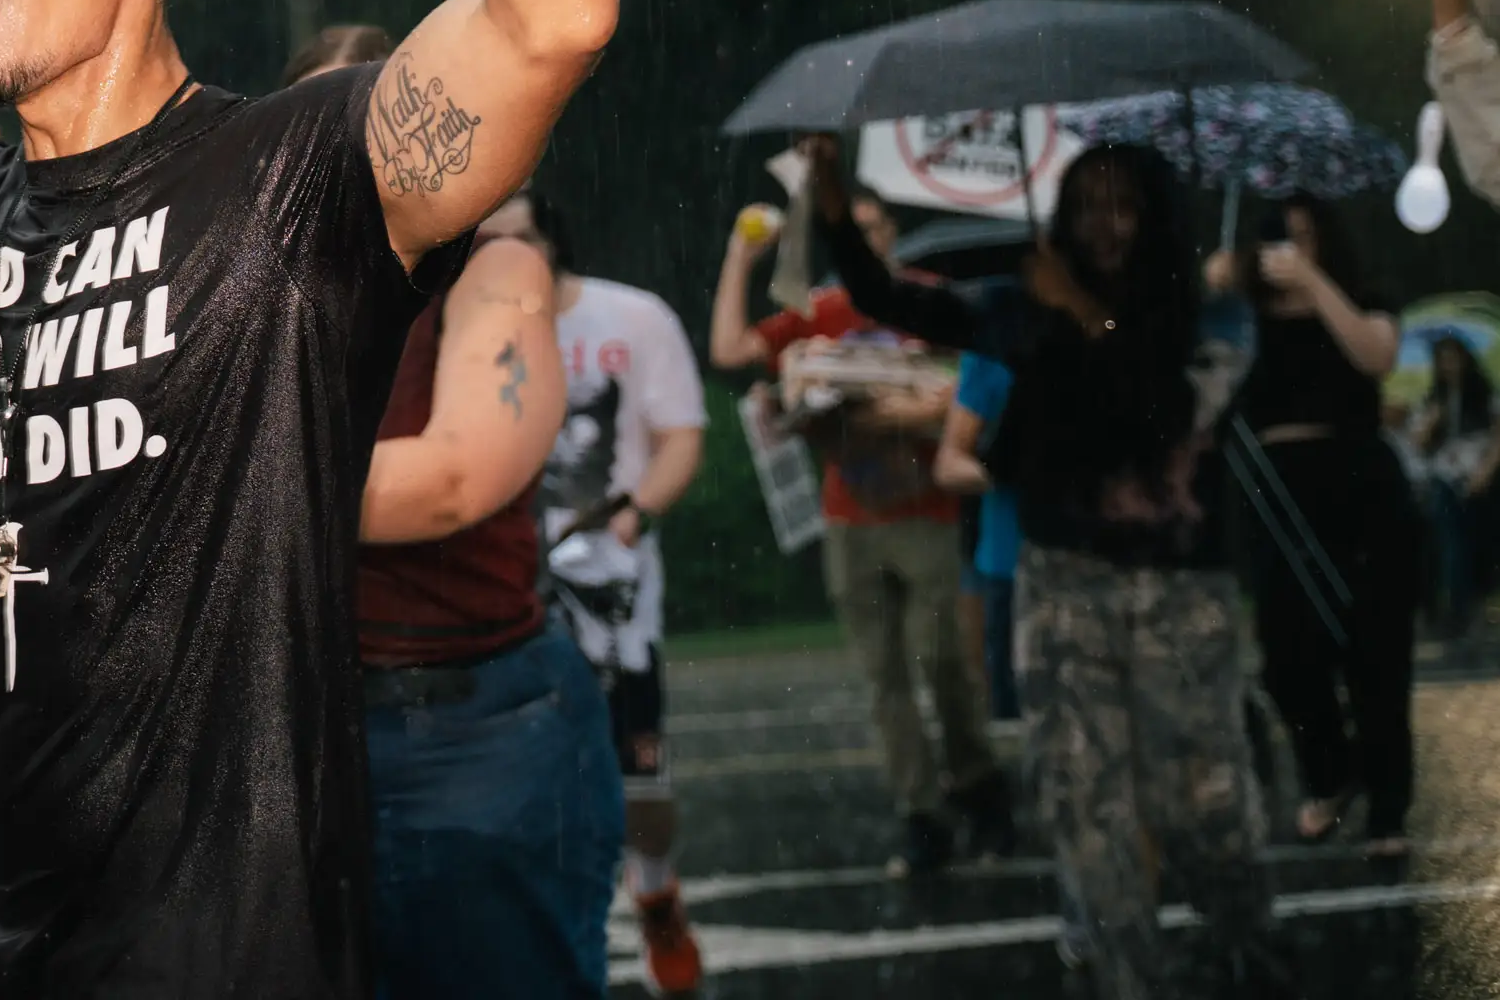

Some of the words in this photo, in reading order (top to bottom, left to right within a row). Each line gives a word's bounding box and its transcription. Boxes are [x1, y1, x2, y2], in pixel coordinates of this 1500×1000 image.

[40, 205, 170, 304] CAN
[21, 286, 177, 390] WILL
[26, 397, 168, 486] DID.
